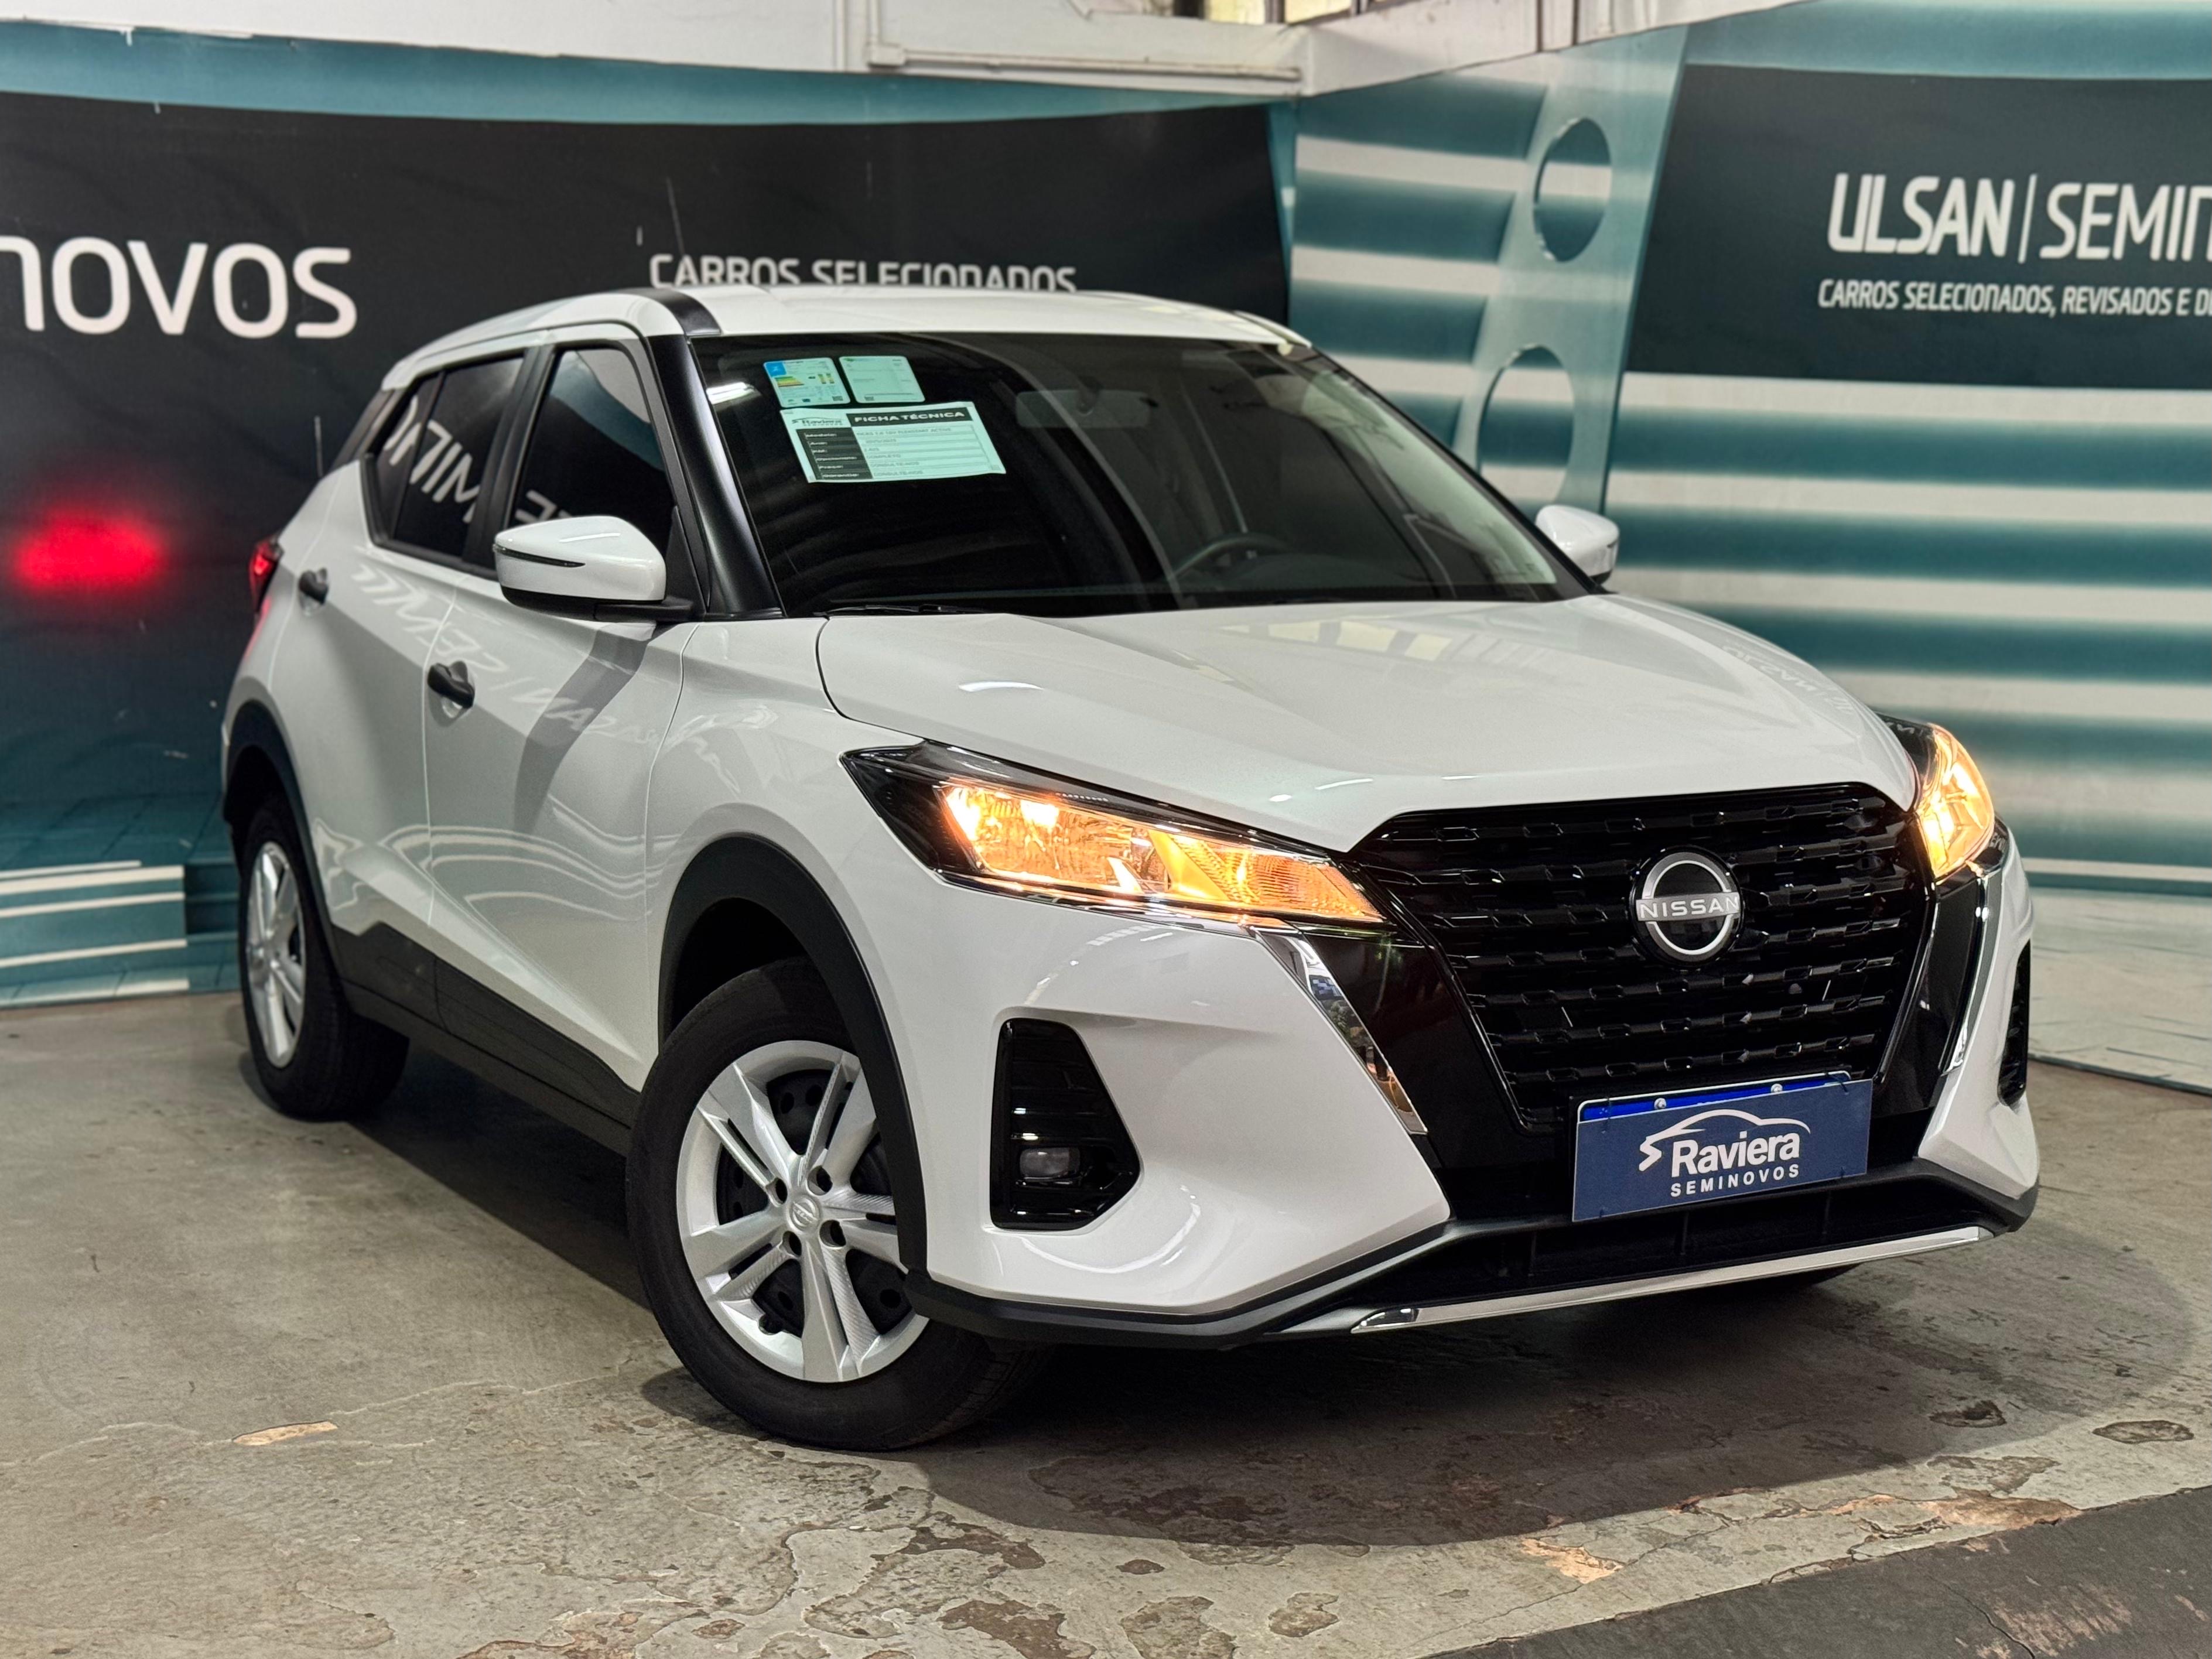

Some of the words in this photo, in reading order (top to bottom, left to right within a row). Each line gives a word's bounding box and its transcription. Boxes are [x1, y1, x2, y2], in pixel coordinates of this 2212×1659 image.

[1828, 173, 2015, 256] ULSAN
[649, 253, 801, 289] CARROS
[1817, 279, 1900, 309] CARROS
[1903, 281, 2056, 318] SELECIONADOS,
[2061, 285, 2174, 316] REVISADOS
[2176, 288, 2192, 316] E
[901, 412, 965, 420] TÉCNICA
[1640, 896, 1739, 919] NISSAN
[1671, 1130, 1800, 1178] Raviera
[1670, 1163, 1800, 1198] SEMINOVOS
